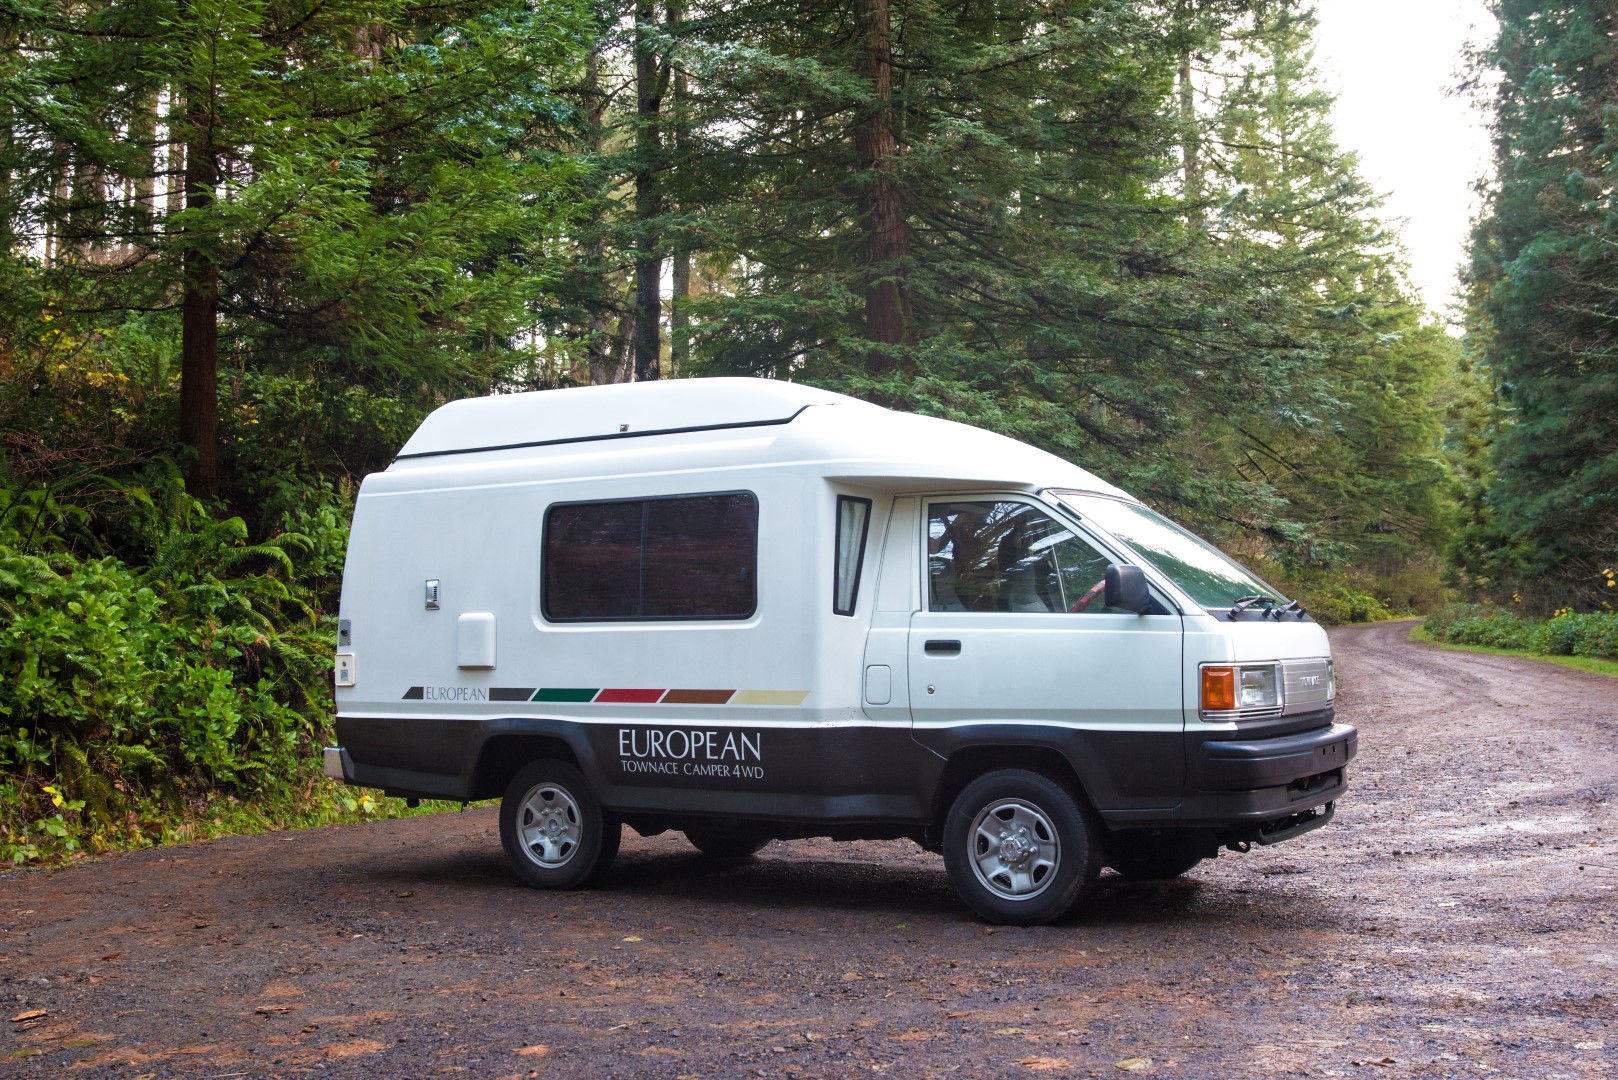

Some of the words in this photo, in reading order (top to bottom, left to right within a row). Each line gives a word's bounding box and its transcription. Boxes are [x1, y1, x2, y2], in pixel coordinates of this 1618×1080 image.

[426, 686, 486, 701] EUROPEAN
[619, 729, 761, 761] EUROPEAN
[620, 760, 679, 774] TOWNACE
[683, 763, 731, 777] CAMPER
[732, 764, 764, 779] 4WD
